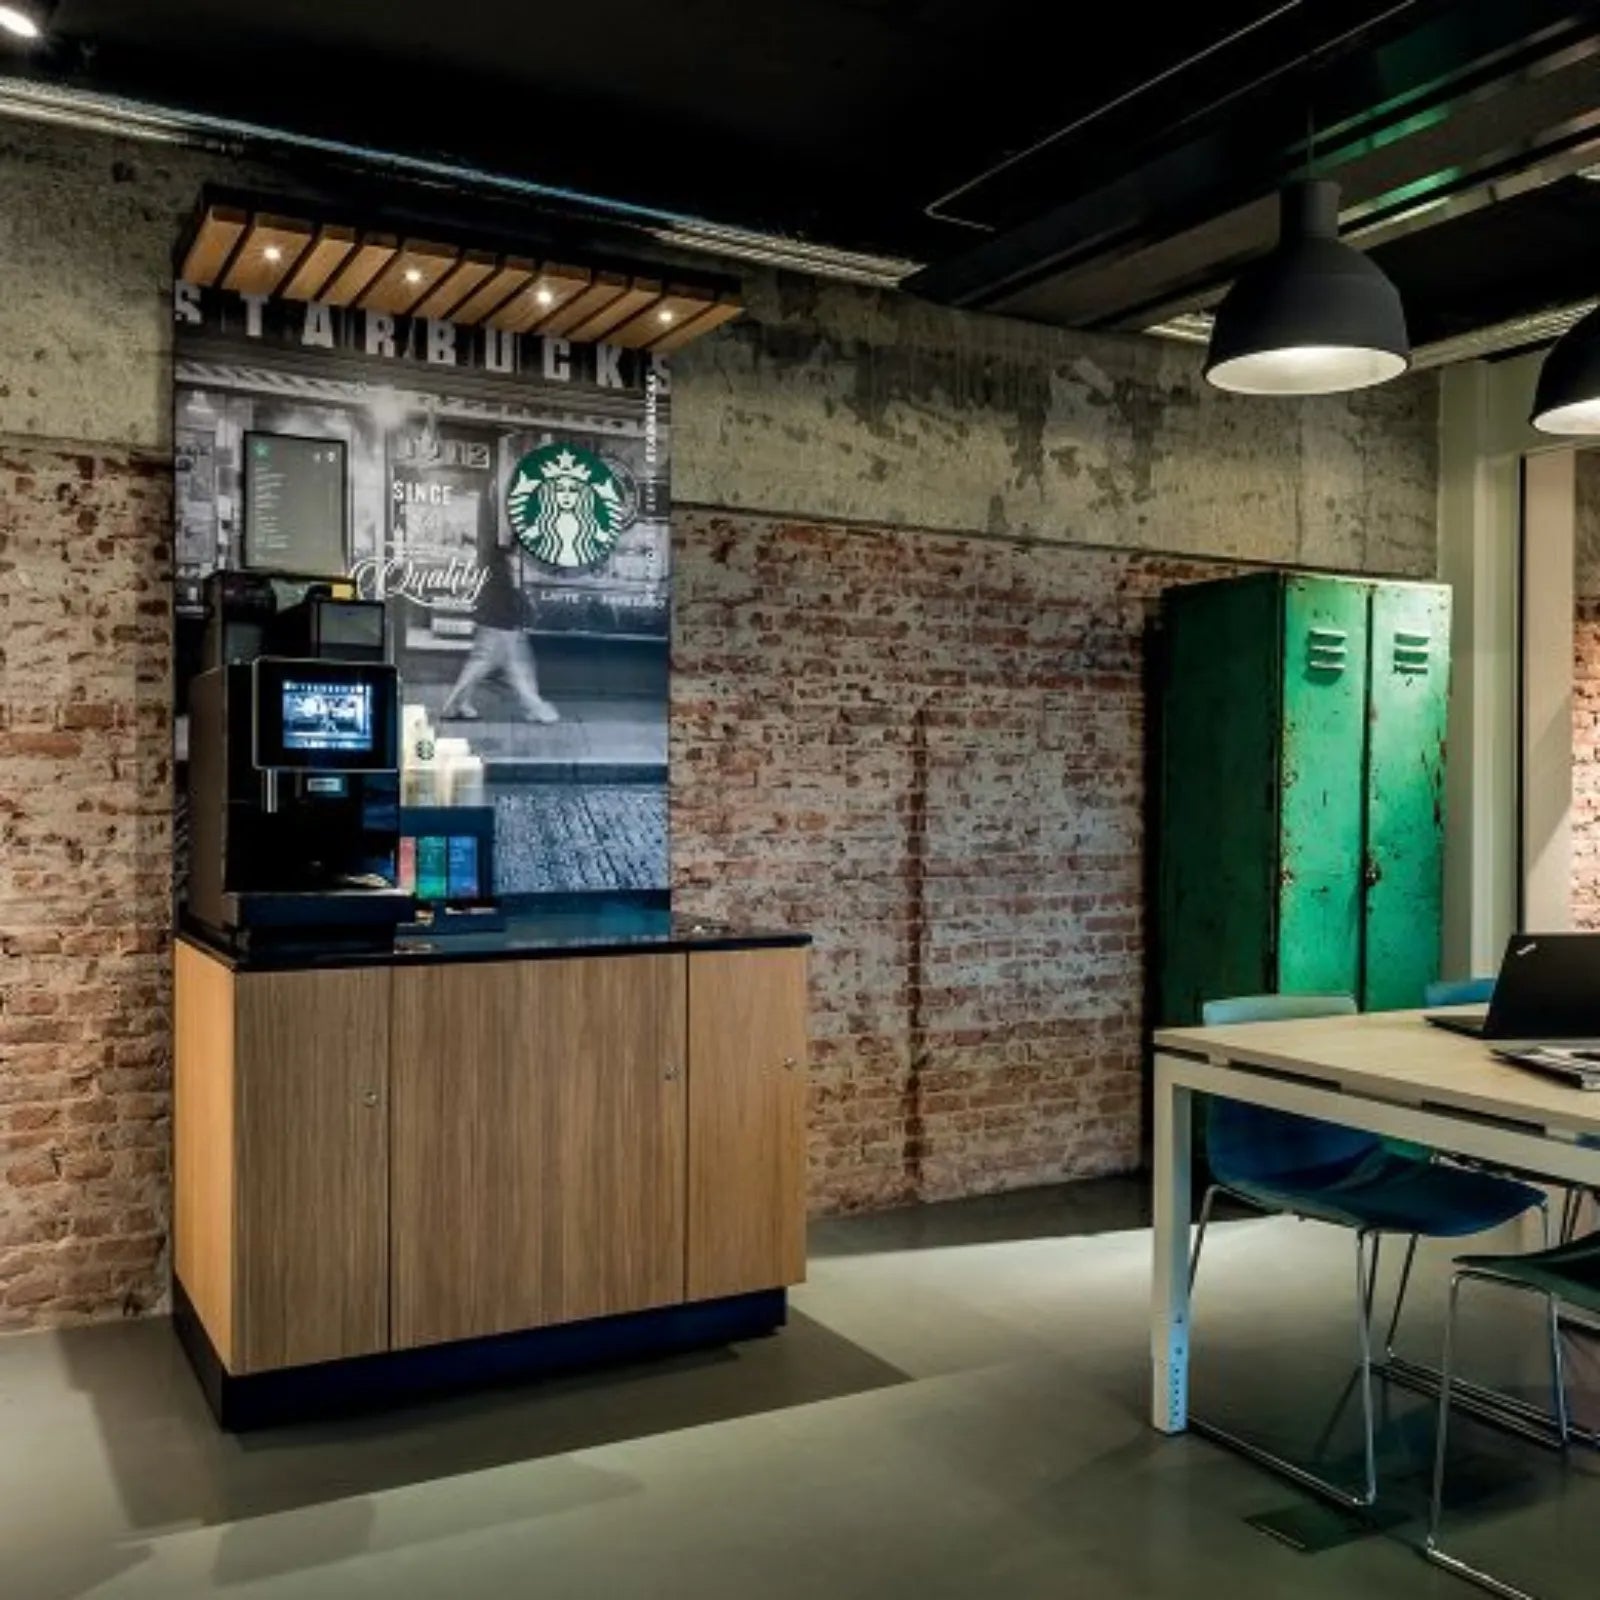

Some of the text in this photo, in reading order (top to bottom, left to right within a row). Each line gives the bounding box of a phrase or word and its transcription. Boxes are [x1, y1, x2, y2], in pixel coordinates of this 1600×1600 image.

[174, 281, 671, 395] STARBUCKS
[392, 481, 452, 506] SINCE
[350, 556, 492, 609] Quality
